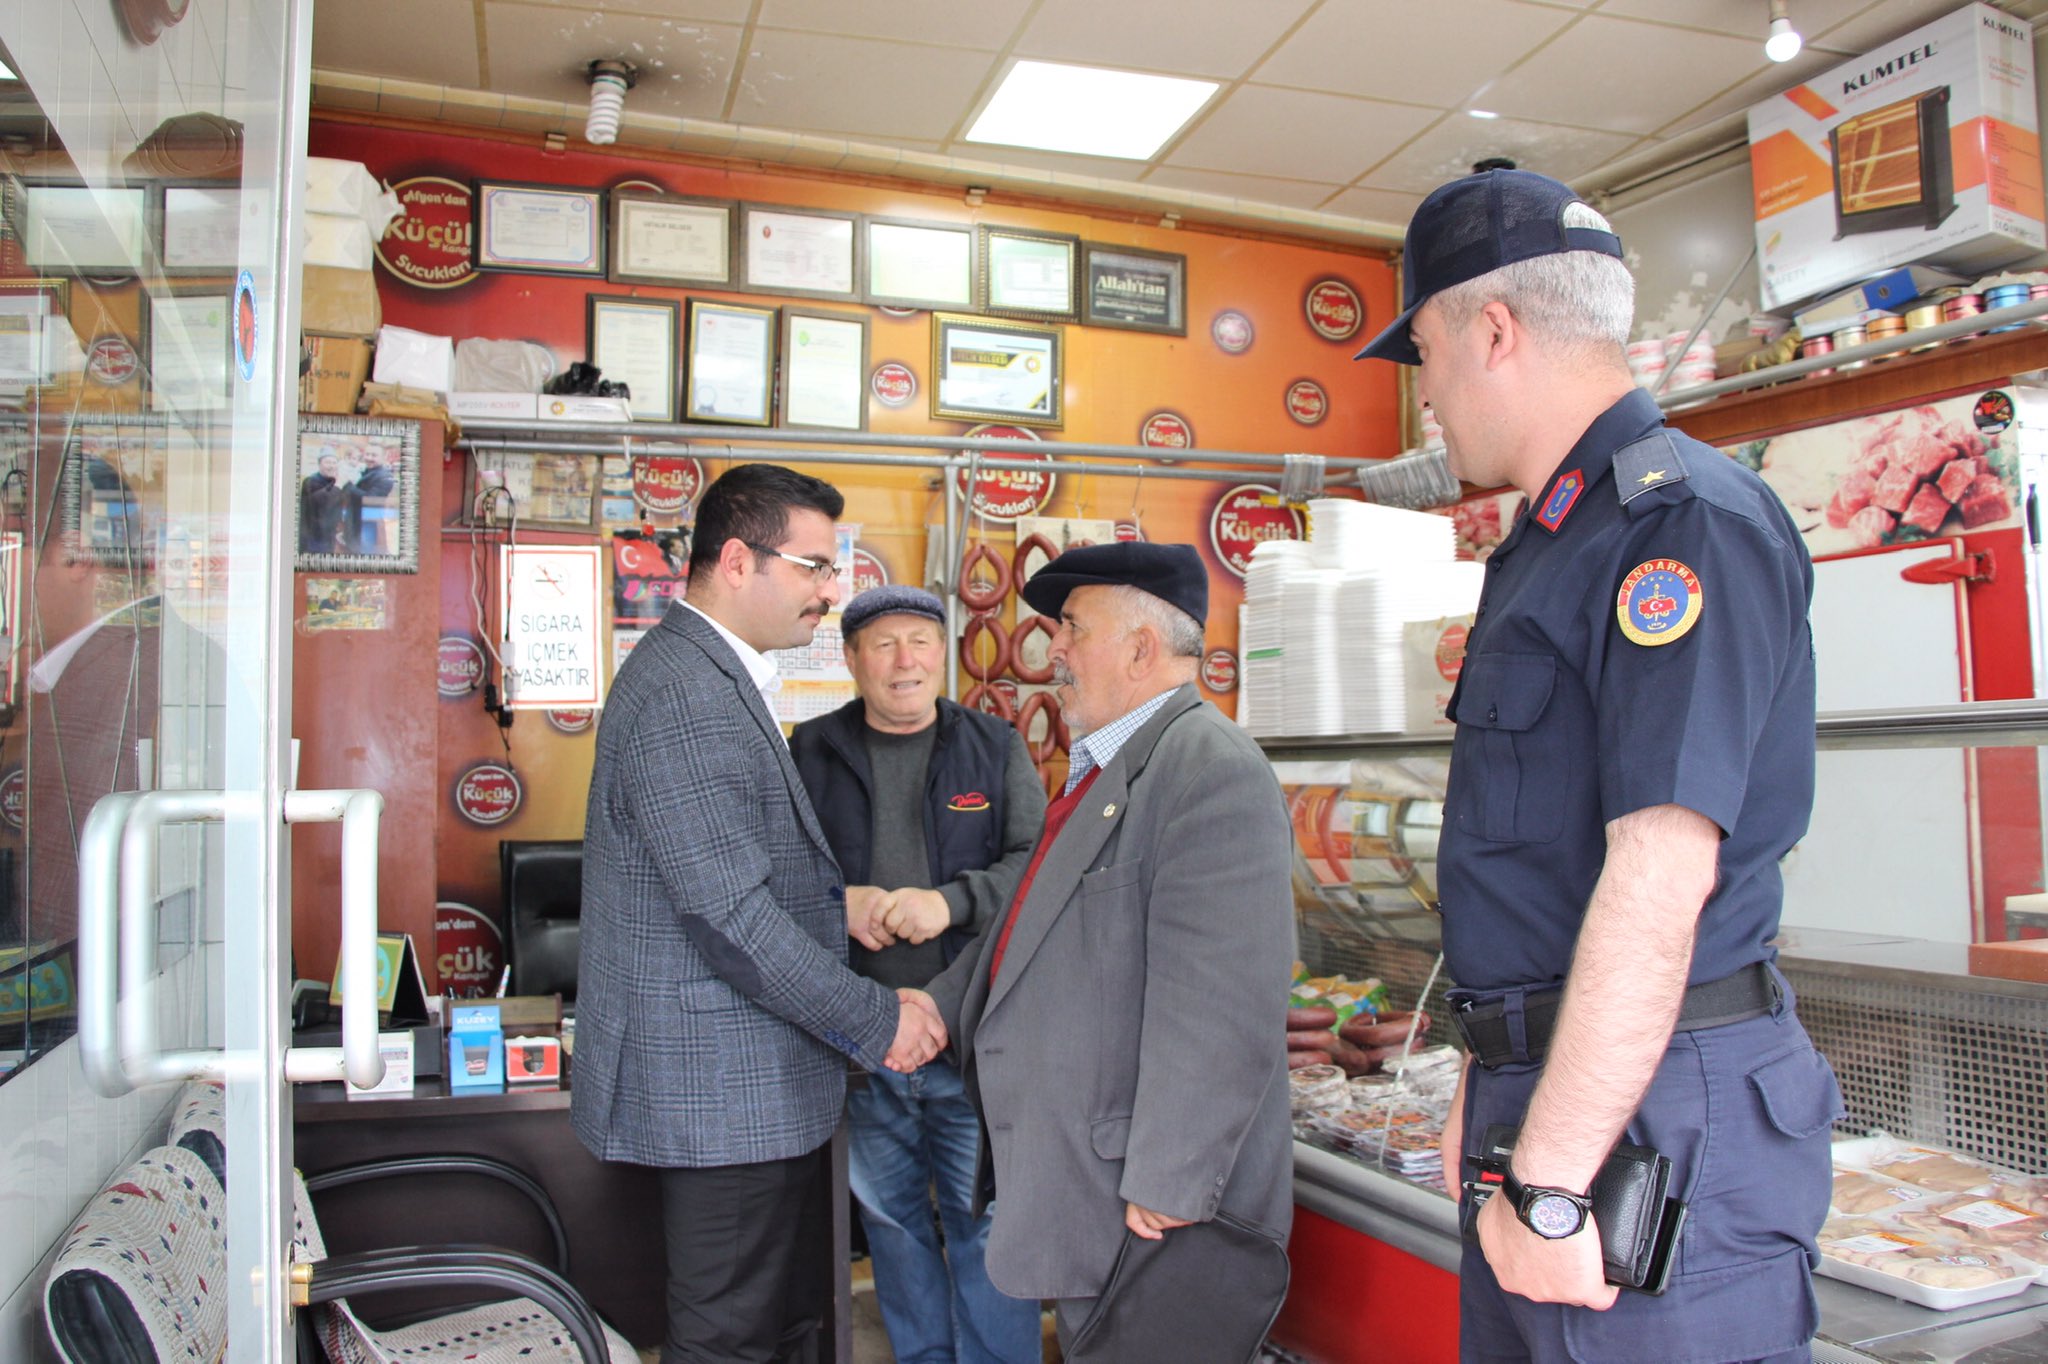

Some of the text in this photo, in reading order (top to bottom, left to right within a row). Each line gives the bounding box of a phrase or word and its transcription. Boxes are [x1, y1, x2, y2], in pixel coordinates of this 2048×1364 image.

[1983, 17, 2025, 41] KUMTEL
[1843, 43, 1939, 95] KUMTEL
[403, 190, 467, 206] Afyon'dan
[1095, 275, 1166, 296] Allah'tan
[635, 467, 695, 489] Küçük
[1221, 520, 1291, 542] Küçük
[1622, 561, 1695, 596] JANDARMA
[438, 660, 480, 675] üçük
[463, 786, 513, 803] Küçük
